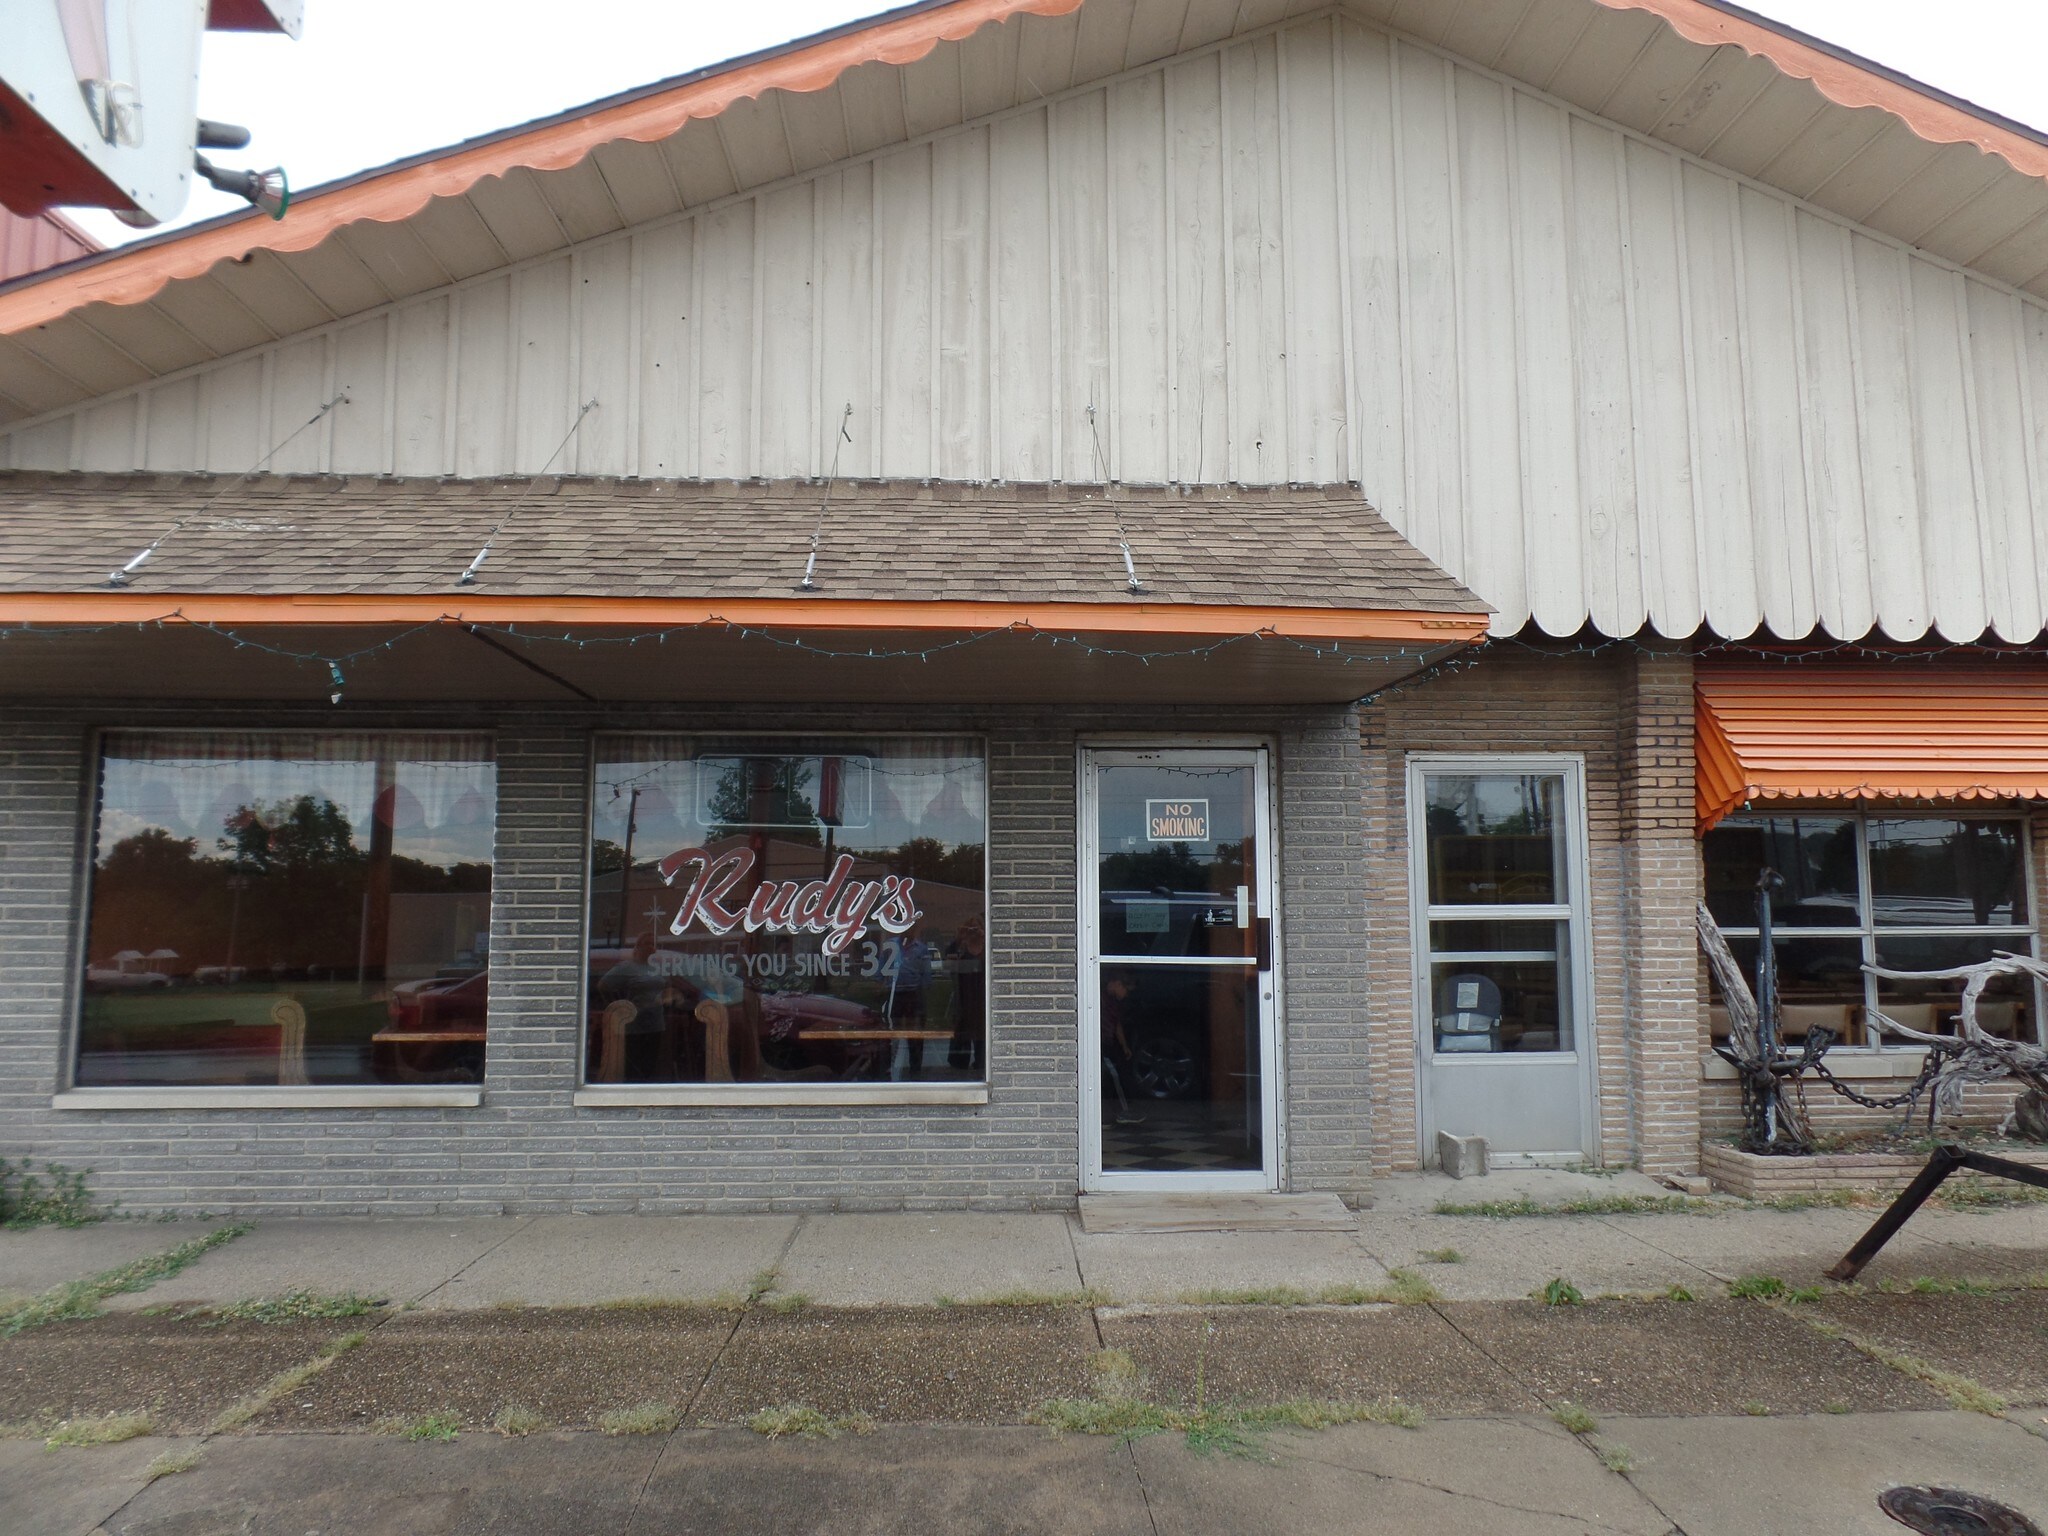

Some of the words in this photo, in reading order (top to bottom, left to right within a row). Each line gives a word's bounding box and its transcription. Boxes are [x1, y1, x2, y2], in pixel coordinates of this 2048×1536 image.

[1165, 804, 1192, 816] NO
[1152, 817, 1205, 837] SMOKING
[657, 847, 923, 956] Rudy's
[647, 953, 738, 978] SERVING
[743, 953, 787, 977] YOU
[794, 953, 851, 977] SINCE
[860, 941, 900, 977] 32
